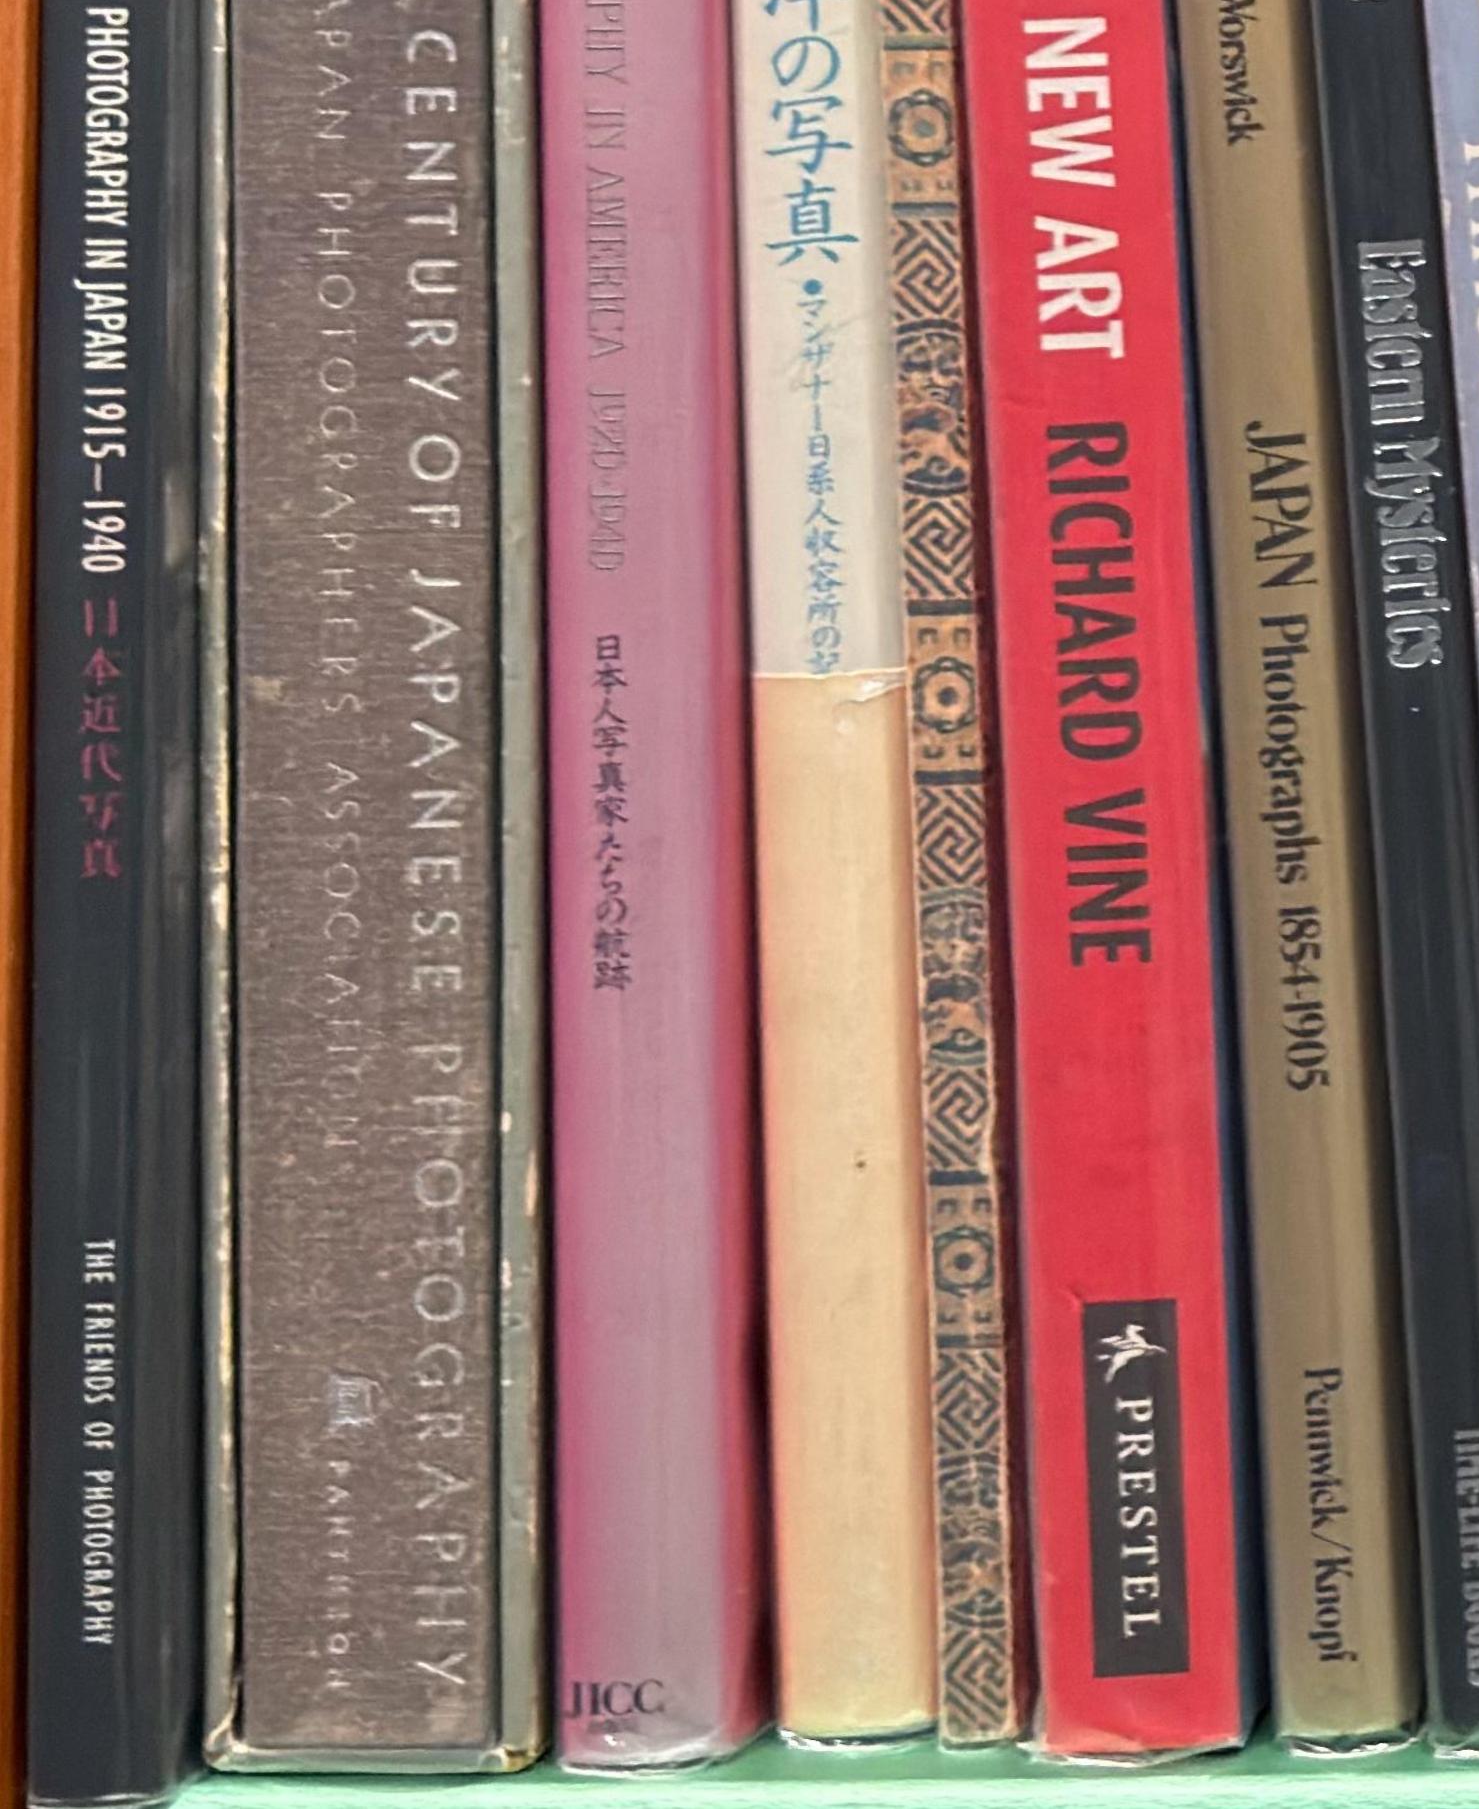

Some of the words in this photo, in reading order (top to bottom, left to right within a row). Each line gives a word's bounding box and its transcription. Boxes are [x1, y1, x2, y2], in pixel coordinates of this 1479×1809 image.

[85, 7, 129, 230] PHOTOGRAPHY
[1026, 16, 1115, 189] NEW
[84, 241, 127, 272] IN
[403, 29, 461, 408] CENTURY
[1034, 214, 1125, 360] ART
[74, 278, 127, 372] JAPAN
[1359, 238, 1430, 426] Eastern
[407, 437, 462, 531] OF
[1243, 420, 1315, 587] JAPAN
[1363, 436, 1452, 668] Mysteries
[1048, 422, 1141, 760] RICHARD
[409, 567, 462, 992] JAPANESE
[1258, 614, 1322, 885] Photographs
[1067, 789, 1151, 967] VINE
[1280, 907, 1330, 1091] 1854-1905
[84, 1240, 114, 1284] THE
[83, 1302, 114, 1405] FRIENDS
[83, 1420, 114, 1451] OF
[410, 1046, 469, 1686] PHOTOGRAPHY
[82, 1468, 113, 1645] PHOTOGRAPHY
[1115, 1397, 1163, 1636] PRESTEL
[1303, 1368, 1358, 1663] Pennwick/Knopf
[563, 1678, 665, 1718] JICC
